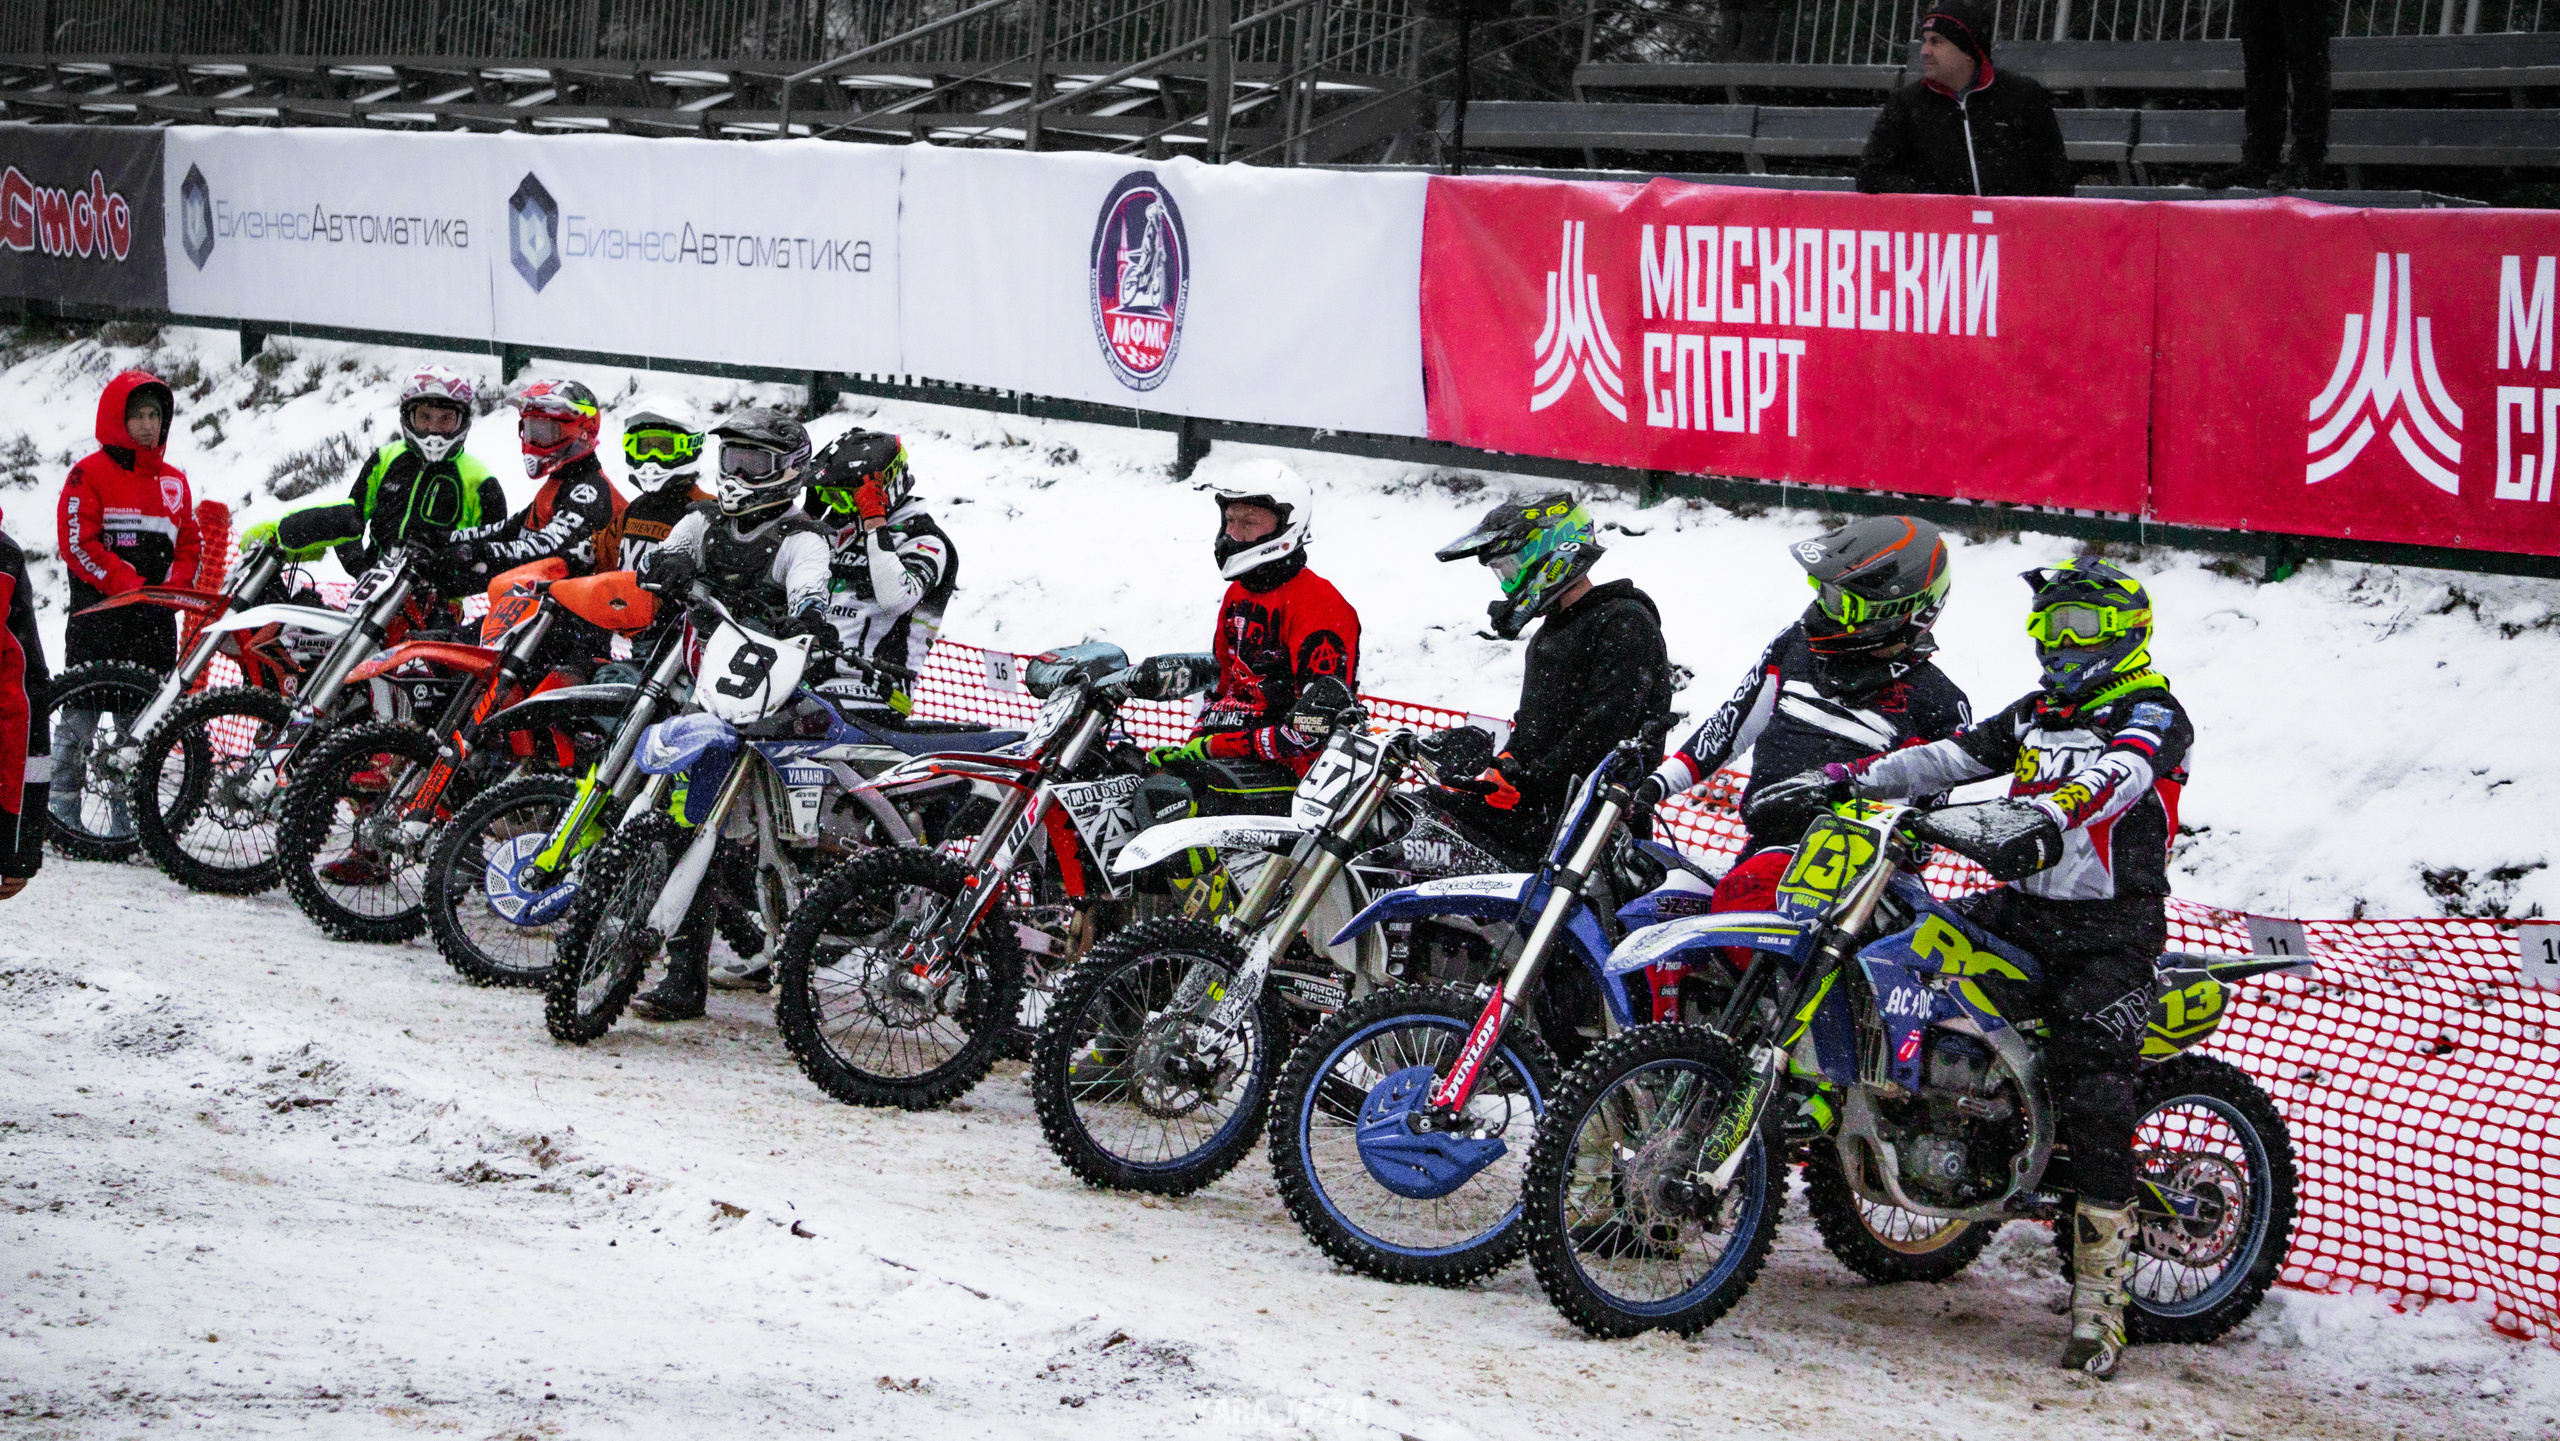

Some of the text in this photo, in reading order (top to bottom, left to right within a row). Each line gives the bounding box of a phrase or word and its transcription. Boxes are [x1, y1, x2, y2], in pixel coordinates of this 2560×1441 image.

[0, 166, 130, 261] Gmoto
[216, 201, 468, 248] БизнесАвтоматика
[567, 215, 872, 273] БизнесАвтоматика
[1640, 210, 1999, 337] МОСКОВСКИЙ
[1112, 317, 1167, 350] МФМС
[1643, 332, 1806, 437] СПОРТ
[1547, 559, 1565, 581] SHOEI
[715, 644, 778, 700] 9
[994, 661, 1009, 681] 16
[1294, 715, 1324, 725] MOOSE
[1299, 725, 1329, 735] RACING
[788, 769, 824, 784] YAMAHA
[1243, 829, 1280, 847] SSMX
[1402, 839, 1451, 866] SSMX
[1787, 829, 1875, 890] 13
[530, 884, 576, 916] ACERBIS
[1757, 935, 1791, 946] SSMX.RU
[2266, 936, 2290, 956] 11
[1294, 979, 1347, 1000] ANARCHY
[1301, 991, 1344, 1008] RACING
[2158, 980, 2222, 1030] 13
[1444, 1014, 1496, 1103] DUNLOP
